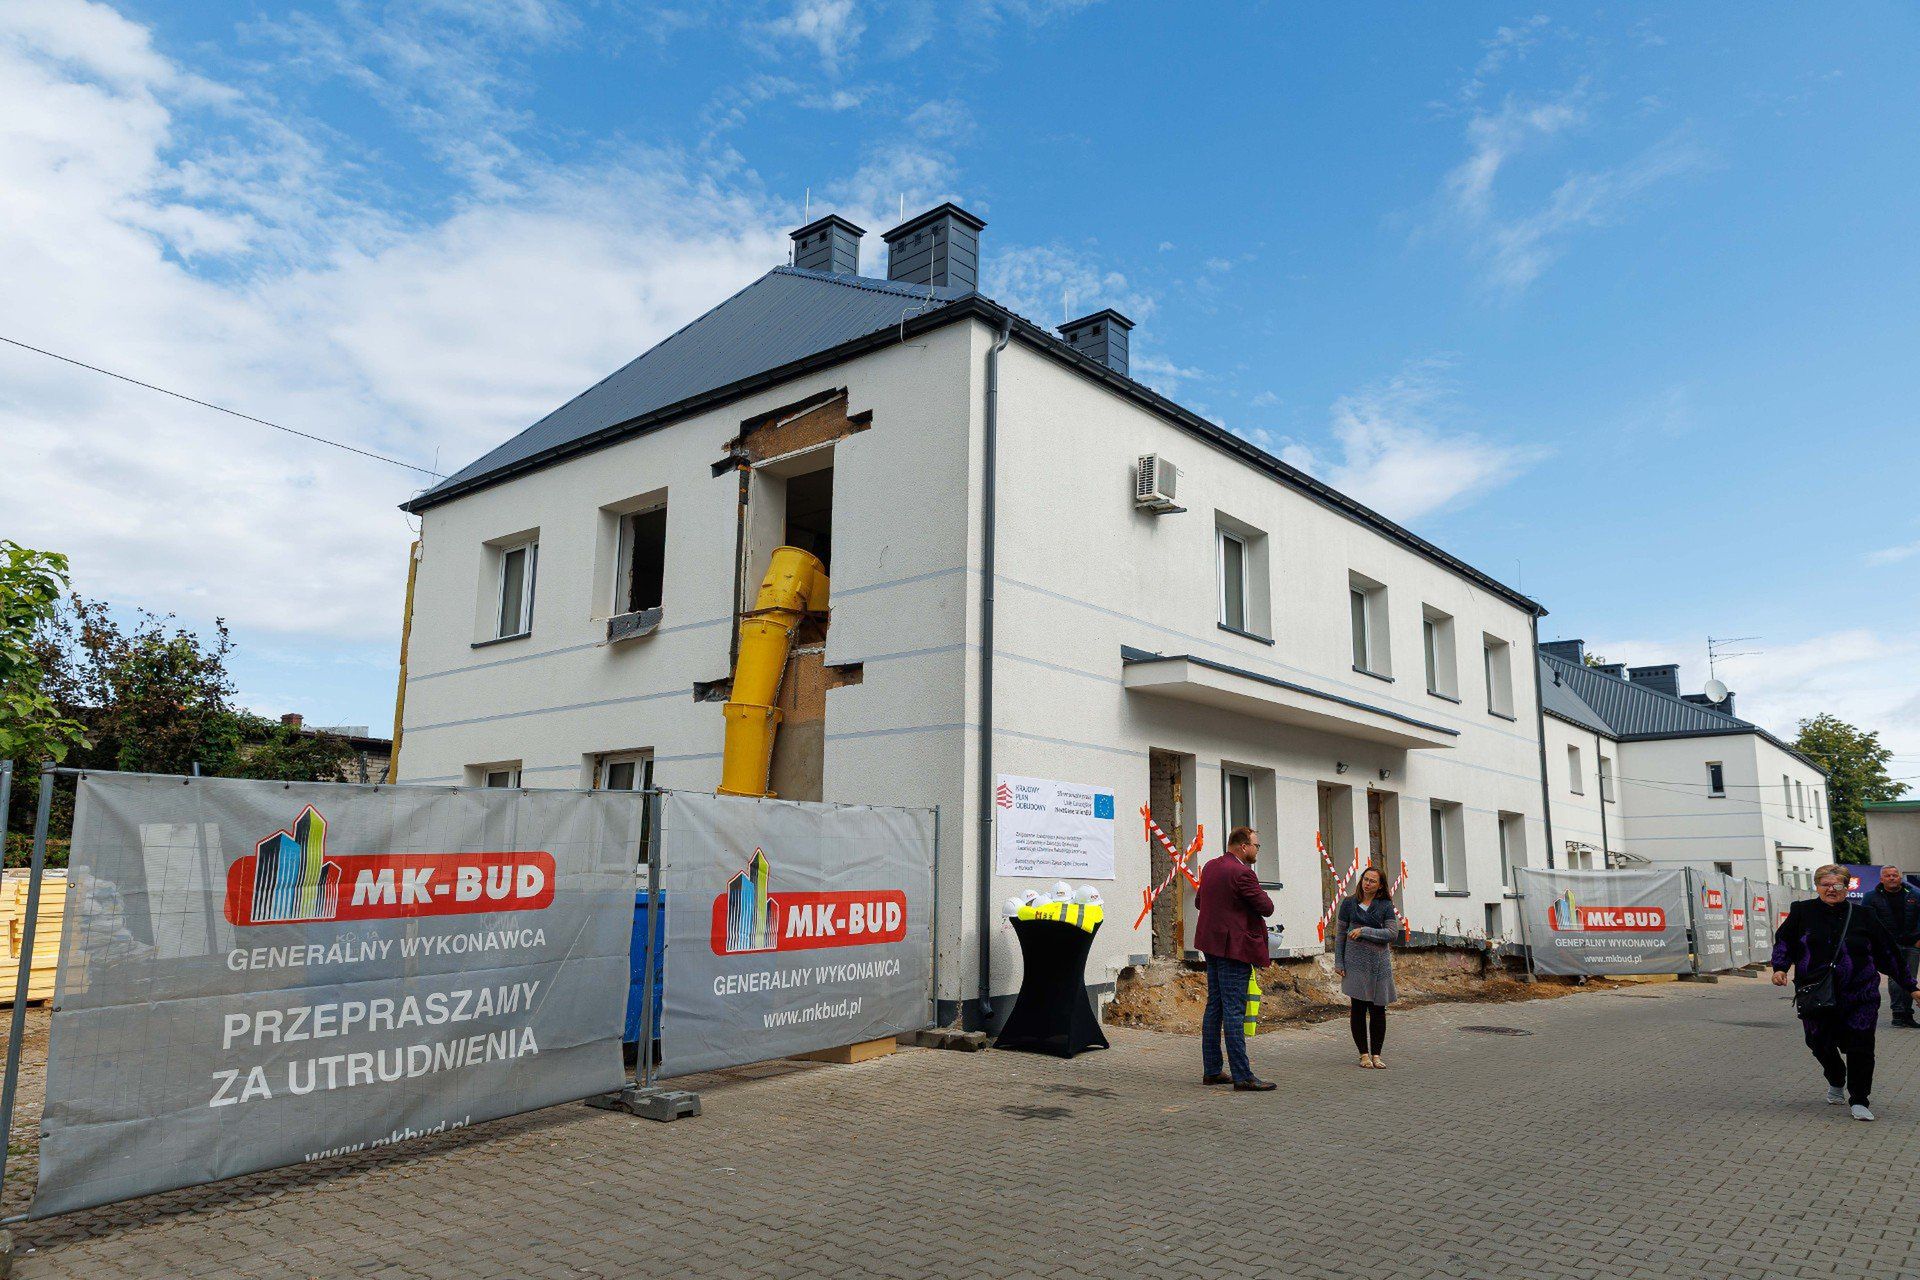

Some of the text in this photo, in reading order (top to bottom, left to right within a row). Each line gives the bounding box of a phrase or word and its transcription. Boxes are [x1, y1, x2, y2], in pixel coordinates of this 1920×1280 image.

[1015, 793, 1029, 801] PLAN
[1015, 801, 1047, 811] ODBUDOWY
[350, 864, 545, 906] MK-BUD
[785, 901, 901, 938] MK-BUD
[1587, 912, 1661, 927] MK-BUD
[227, 928, 546, 971] GENERALNY WYKONAWCA
[1555, 938, 1666, 948] GENERALNY WYKONAWCA
[1584, 953, 1642, 964] www.mkbud.pl
[713, 958, 901, 996] GENERALNY WYKONAWCA
[222, 980, 541, 1050] PRZEPRASZAMY
[763, 997, 862, 1028] www.mkbud.pl
[209, 1026, 539, 1108] ZA UTRUDNIENIA
[304, 1115, 470, 1163] wwwmkbudl
